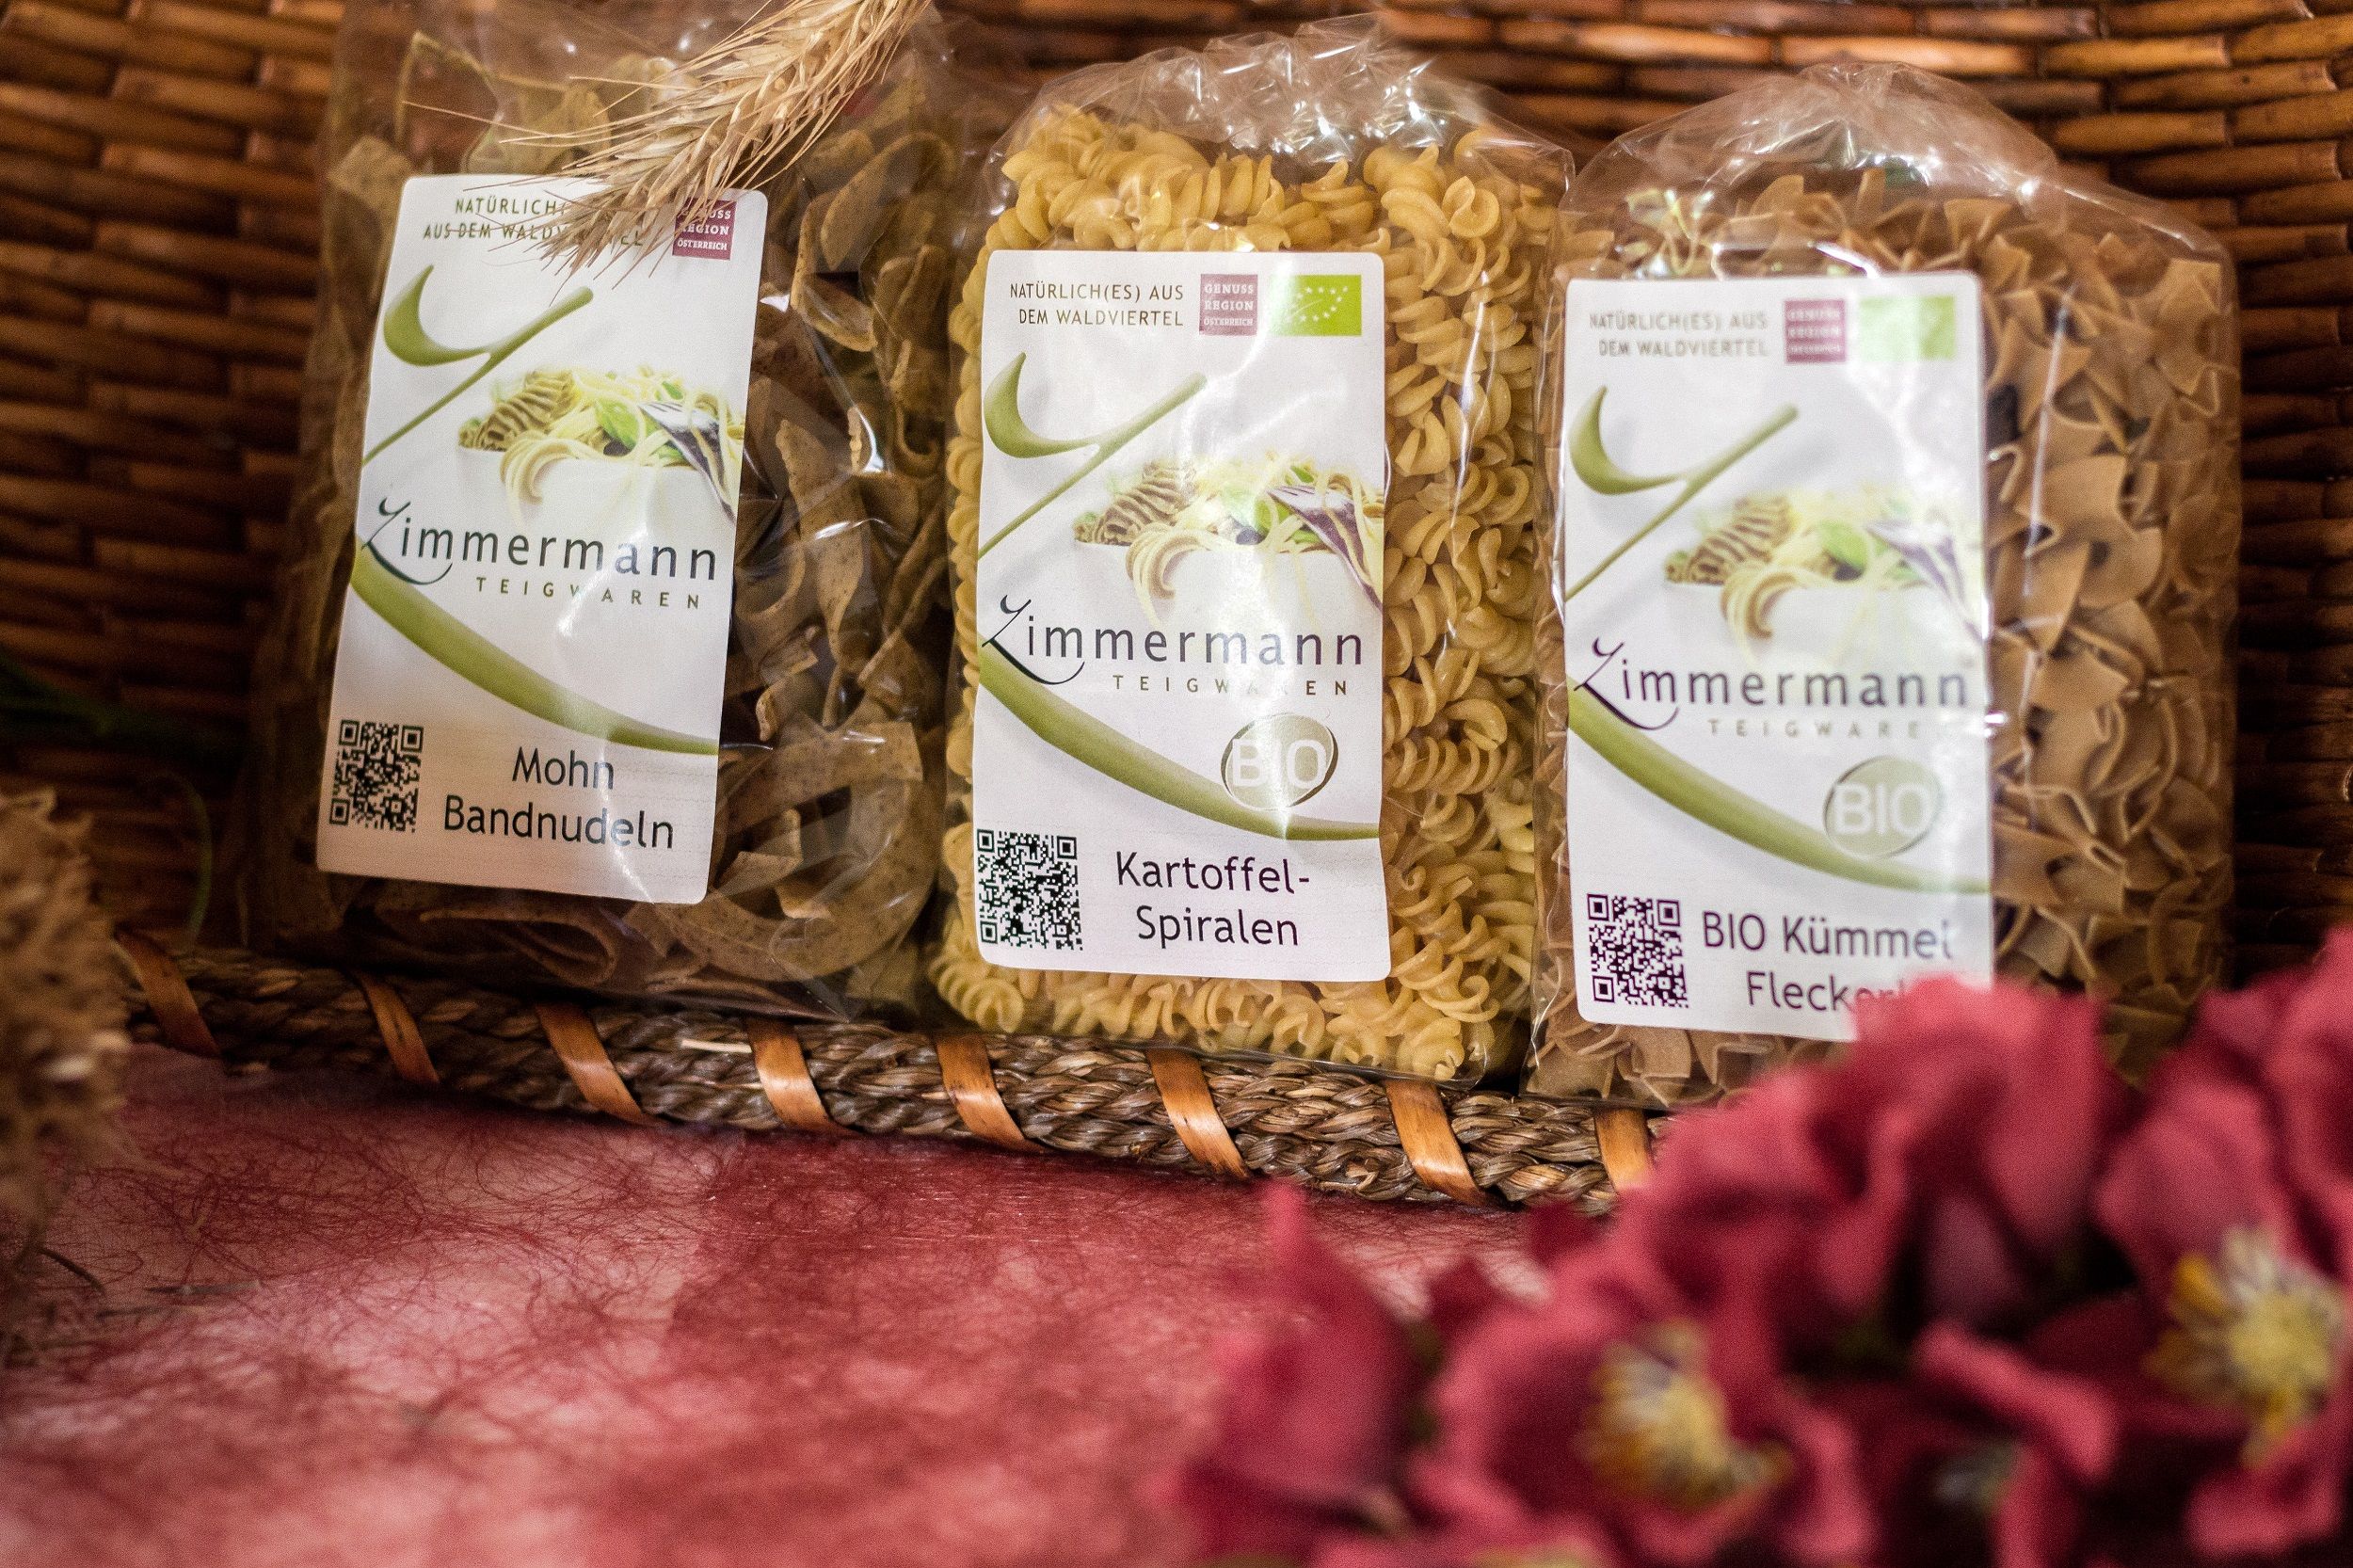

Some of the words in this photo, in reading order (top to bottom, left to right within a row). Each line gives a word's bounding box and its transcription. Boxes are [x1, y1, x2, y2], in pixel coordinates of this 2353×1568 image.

[423, 223, 451, 240] AUS
[457, 222, 492, 239] DEM
[677, 237, 728, 251] ÖSTERREICH
[681, 224, 730, 235] EGION
[1009, 280, 1142, 303] NATÜRLICH(ES)
[1148, 284, 1184, 301] AUS
[1204, 282, 1255, 295] GENUSS
[1018, 309, 1048, 325] DEM
[1055, 309, 1184, 327] WALDVIERTEL
[1204, 299, 1255, 312] REGION
[1589, 309, 1722, 333] NATÜRLICH(ES)
[1728, 311, 1769, 330] AUS
[1598, 339, 1630, 358] DEM
[1636, 339, 1770, 358] WALDVIERTEL
[360, 496, 717, 585] Zimmermann
[981, 594, 1363, 685] Zimmermann
[1573, 636, 1968, 731] Zimmermann
[1706, 717, 1920, 739] TEIGWARE
[511, 745, 616, 790] Mohn
[1231, 738, 1328, 790] BIO
[443, 794, 675, 849] Bandnudeln
[1835, 782, 1931, 836] BIO
[1115, 851, 1310, 894] Kartoffel-
[1135, 904, 1300, 950] Spiralen
[1702, 910, 1767, 952] BIO
[1782, 915, 1954, 960] Kümmel
